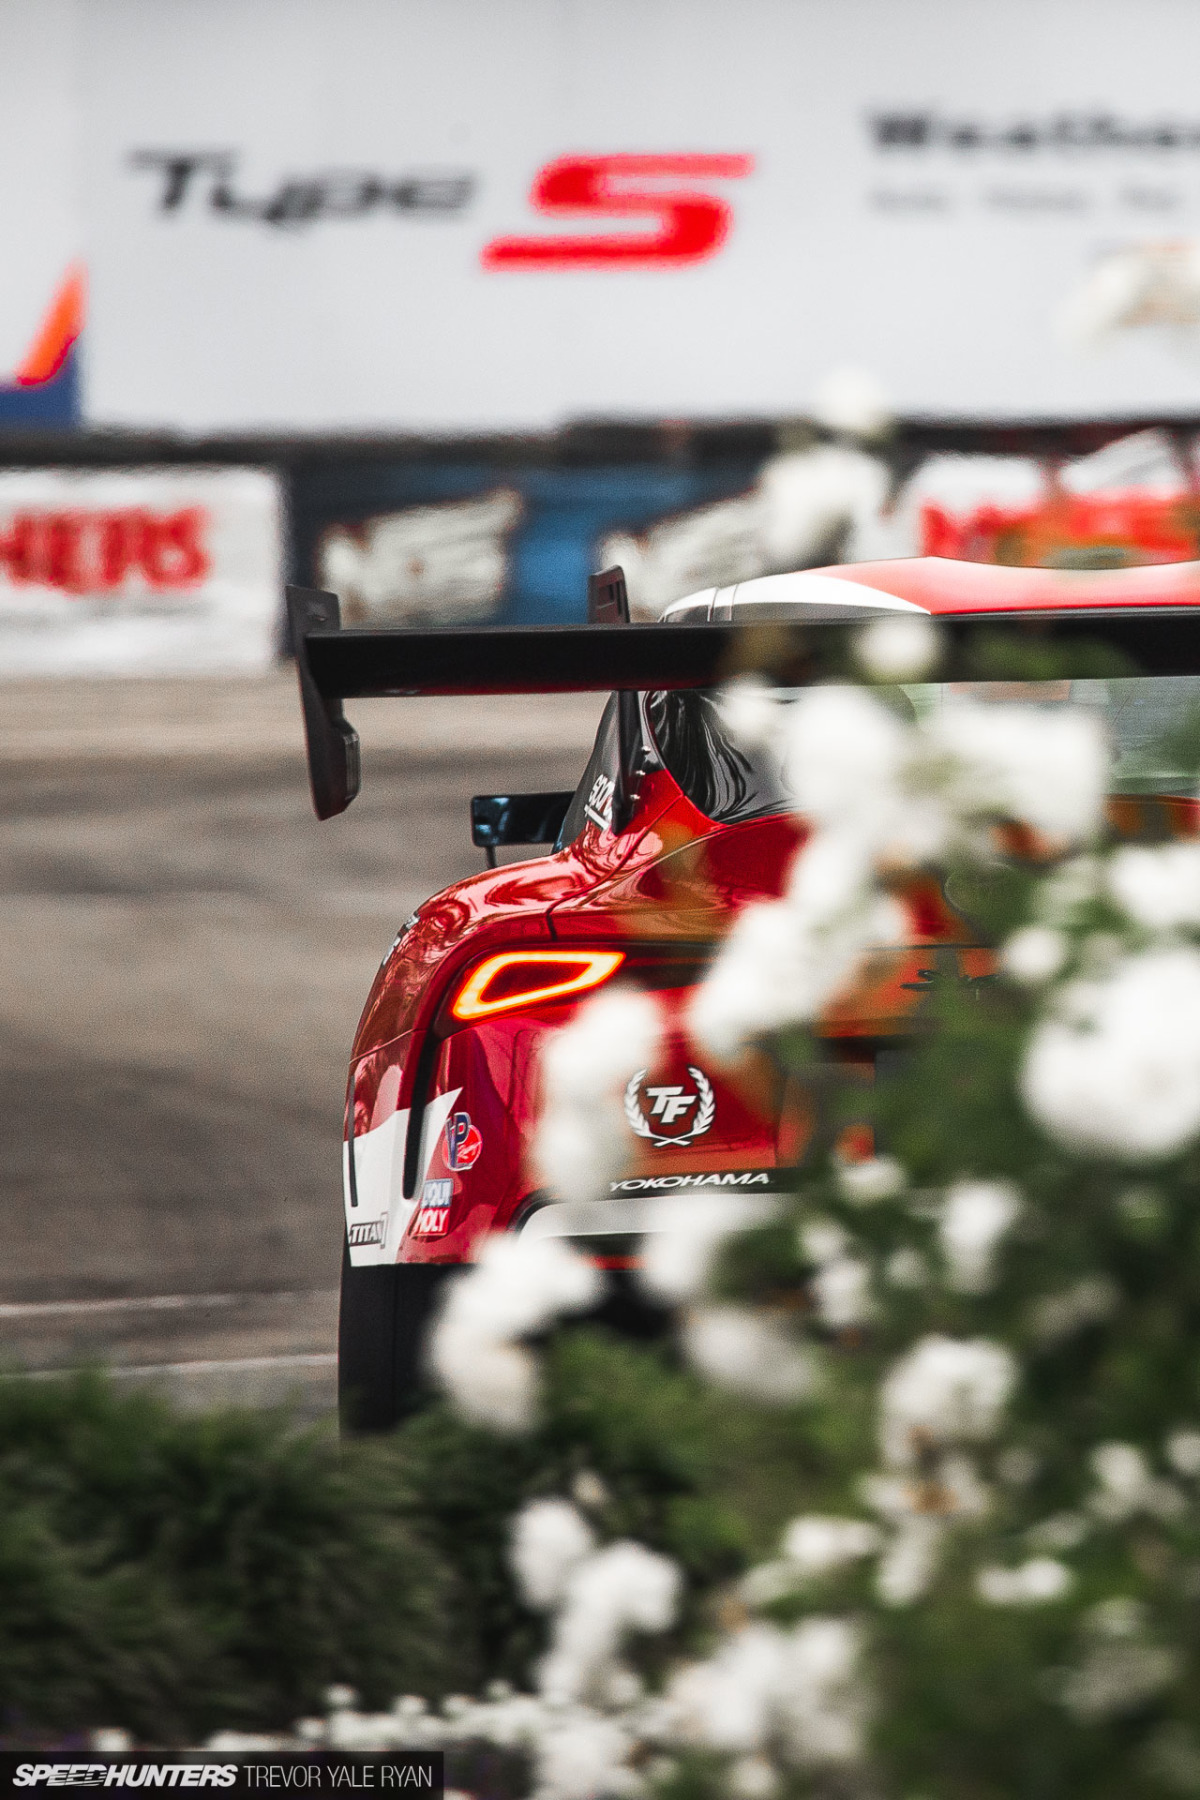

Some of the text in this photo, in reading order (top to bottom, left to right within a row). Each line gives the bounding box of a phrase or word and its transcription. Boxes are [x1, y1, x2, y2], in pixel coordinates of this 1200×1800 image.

[128, 147, 757, 272] Type S
[646, 1086, 697, 1123] TF
[609, 1172, 770, 1192] YOKOHAMA
